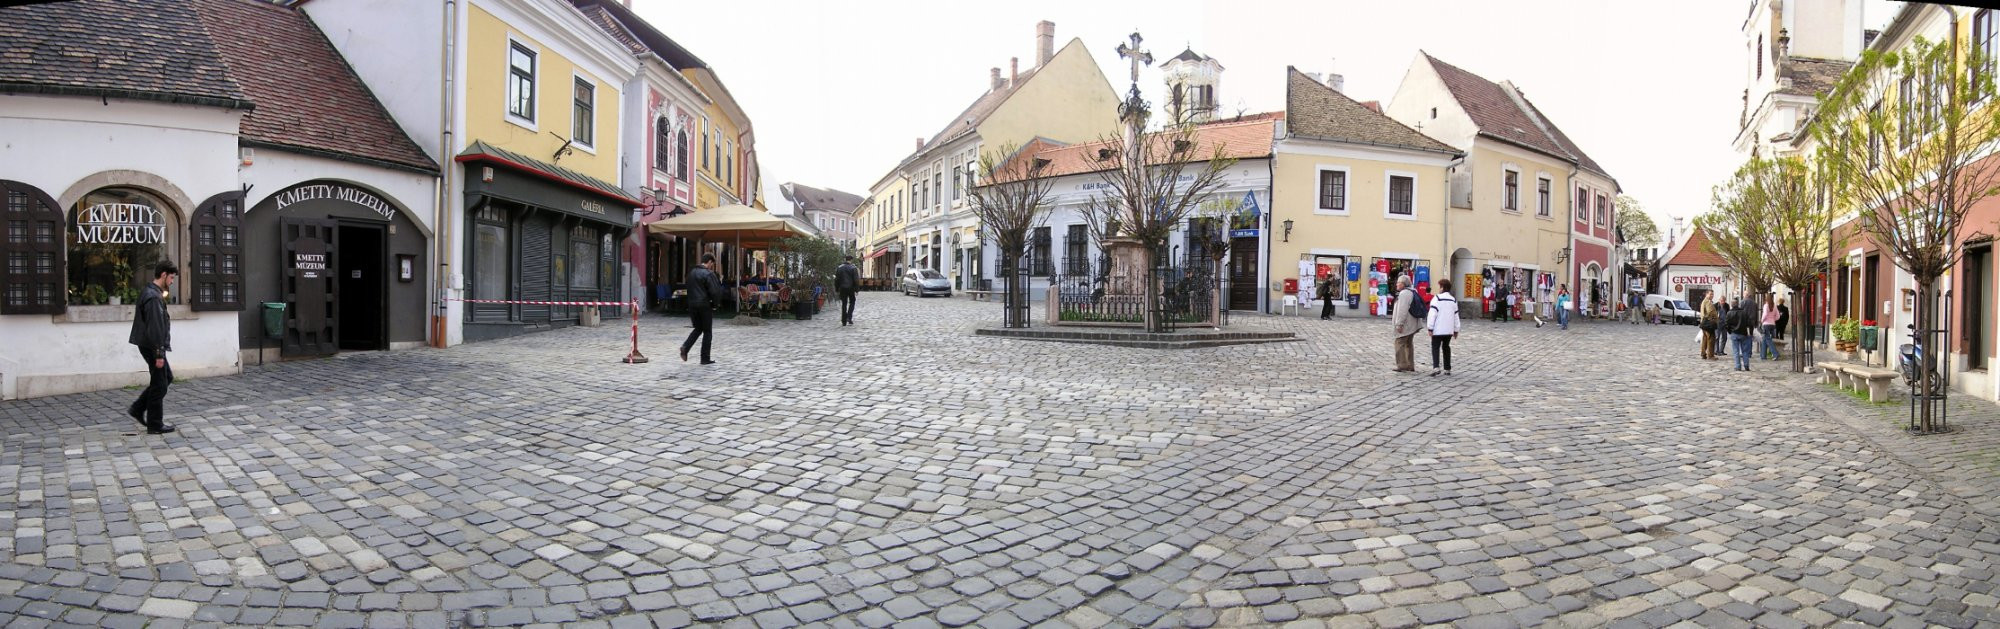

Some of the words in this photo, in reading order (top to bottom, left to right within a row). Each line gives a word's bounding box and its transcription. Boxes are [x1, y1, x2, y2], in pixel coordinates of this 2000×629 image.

[275, 184, 334, 210] KMETTY
[88, 203, 157, 224] KMETTY
[1672, 275, 1722, 285] CENTRUM
